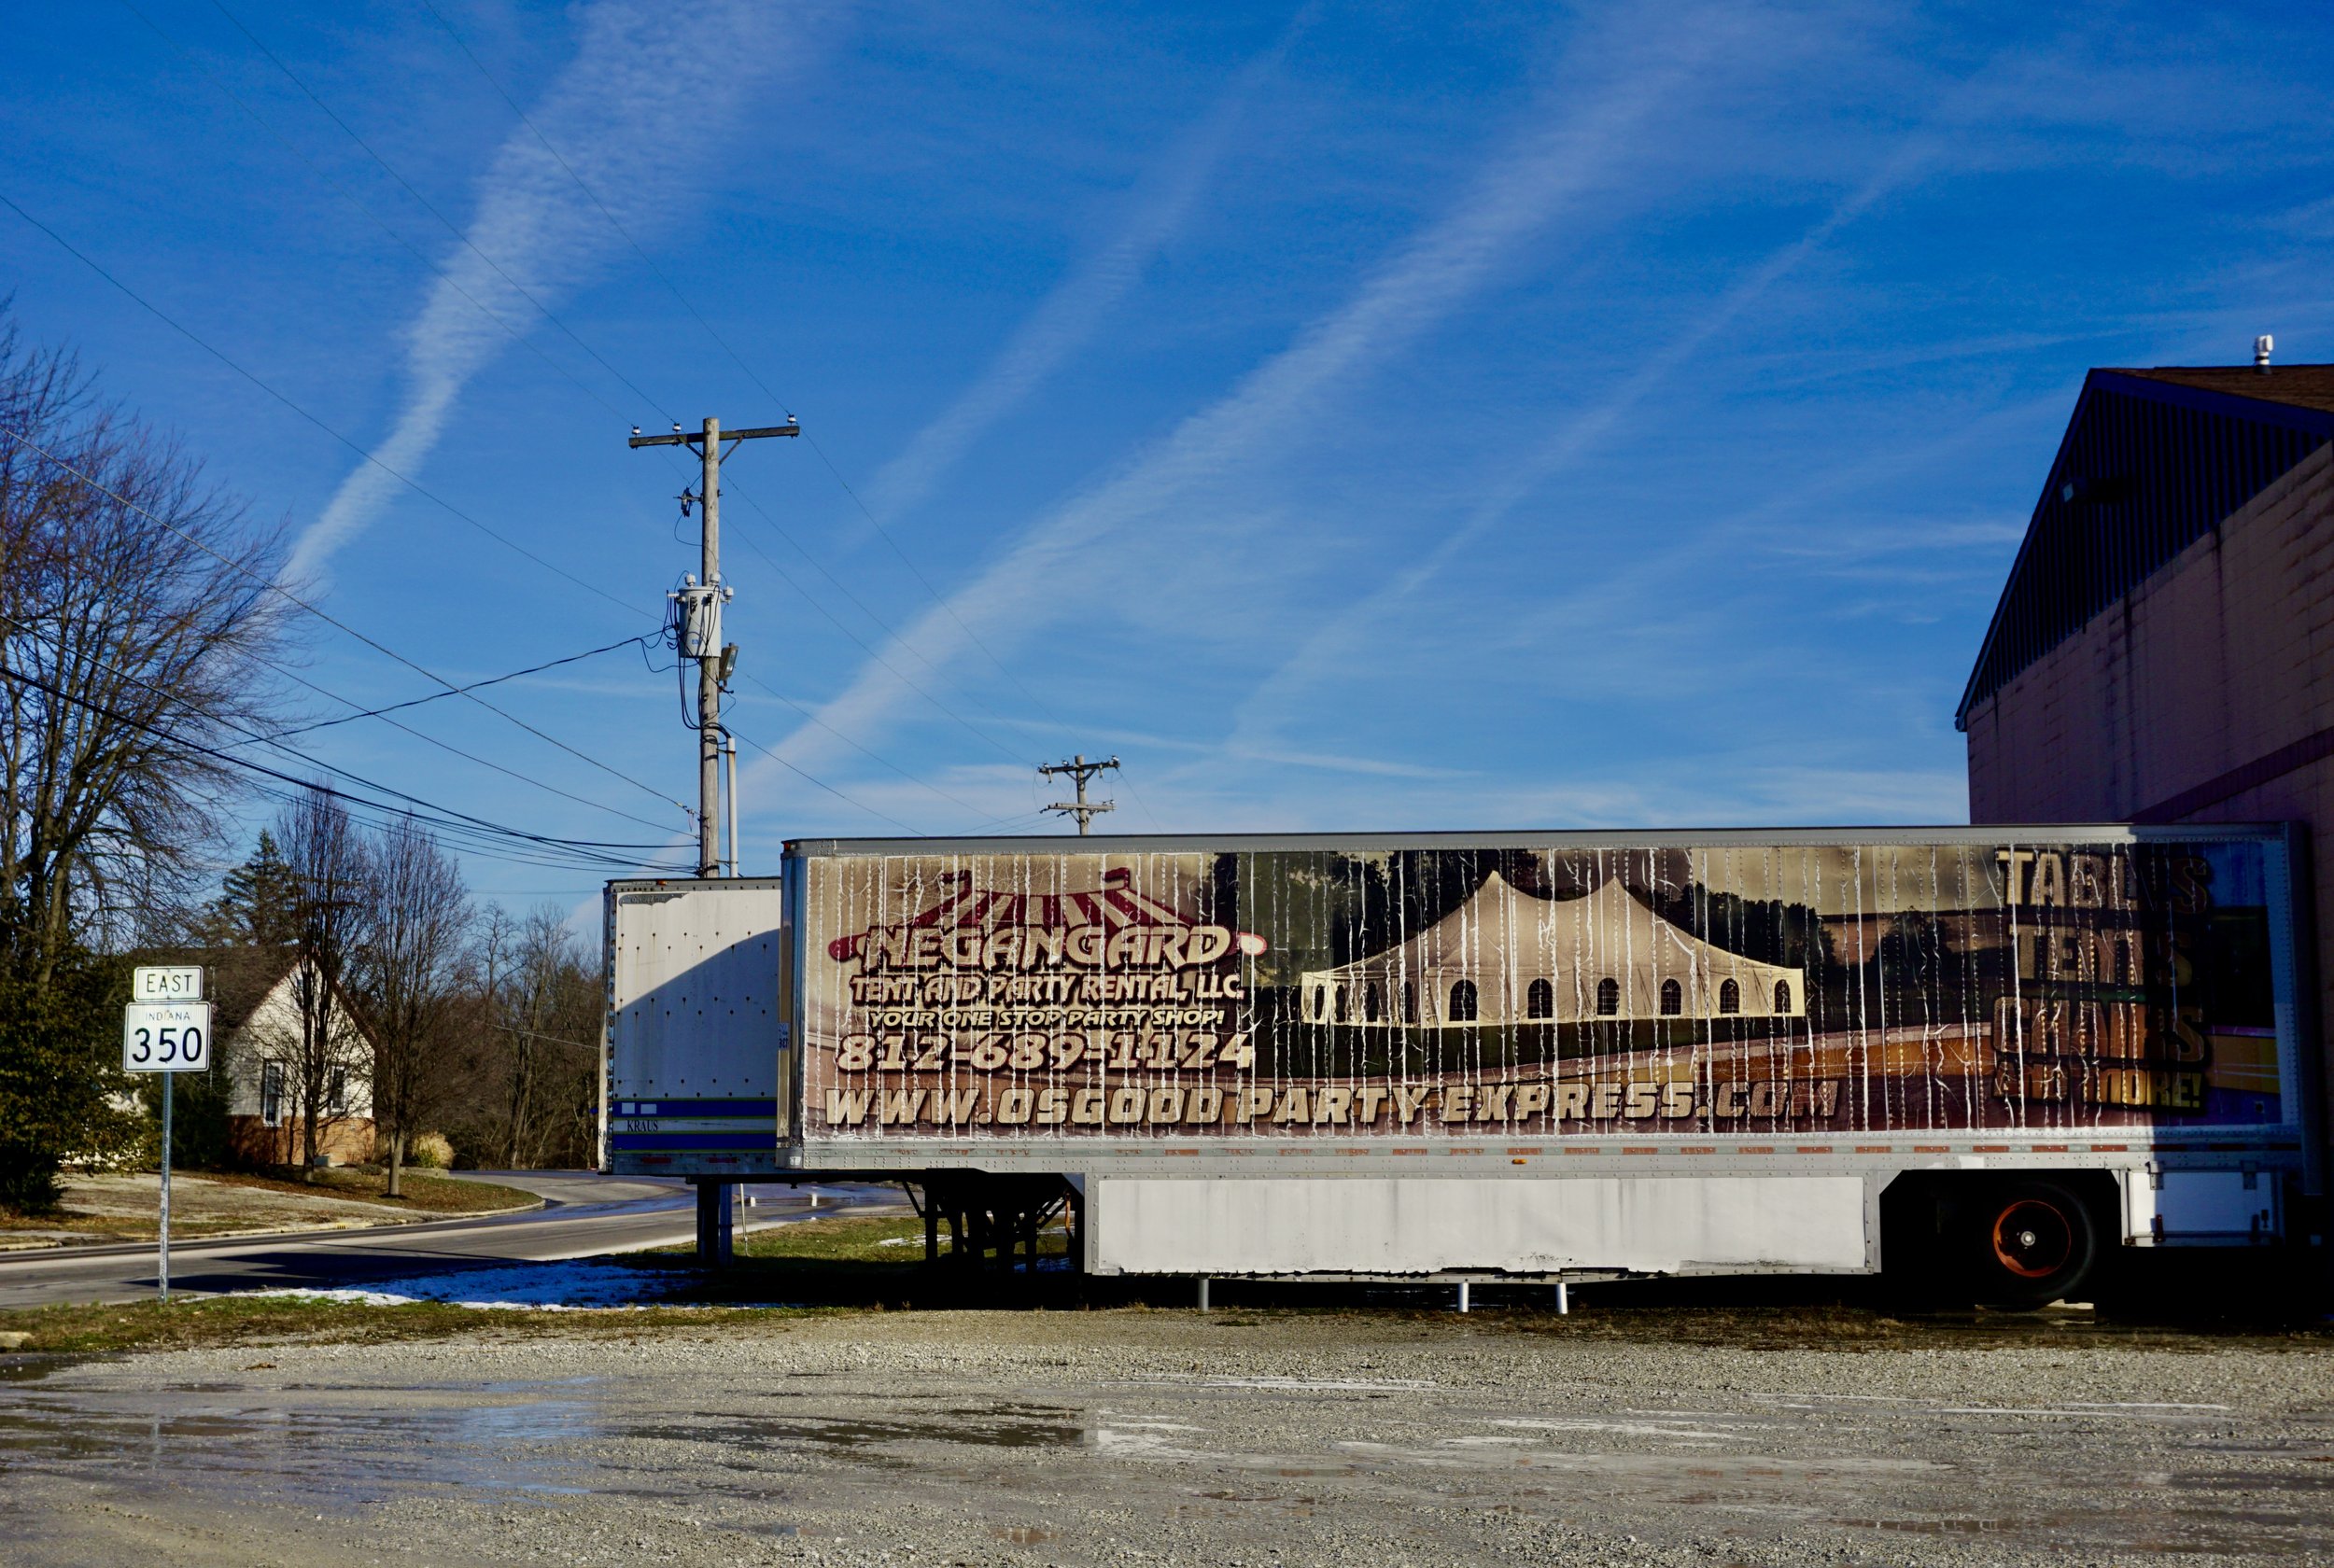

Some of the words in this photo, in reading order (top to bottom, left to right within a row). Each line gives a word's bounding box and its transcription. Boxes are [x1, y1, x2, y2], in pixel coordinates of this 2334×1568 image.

[1996, 849, 2208, 915] TABLS
[863, 924, 1232, 972] NEGANGARD
[146, 973, 193, 994] EAST
[851, 975, 917, 1003] TENT
[924, 975, 982, 1004] AND
[990, 975, 1072, 1004] PARTY
[145, 1011, 191, 1022] INDIANA
[869, 1011, 937, 1028] YOUR
[942, 1011, 992, 1028] ONE
[999, 1011, 1062, 1027] STOP
[1067, 1011, 1147, 1027] PARTY
[1152, 1010, 1225, 1026] SHOP!
[1992, 995, 2206, 1063] CHAIRS
[132, 1027, 203, 1063] 350
[837, 1033, 1255, 1071] 812-689-1124
[626, 1119, 659, 1133] KRAUS
